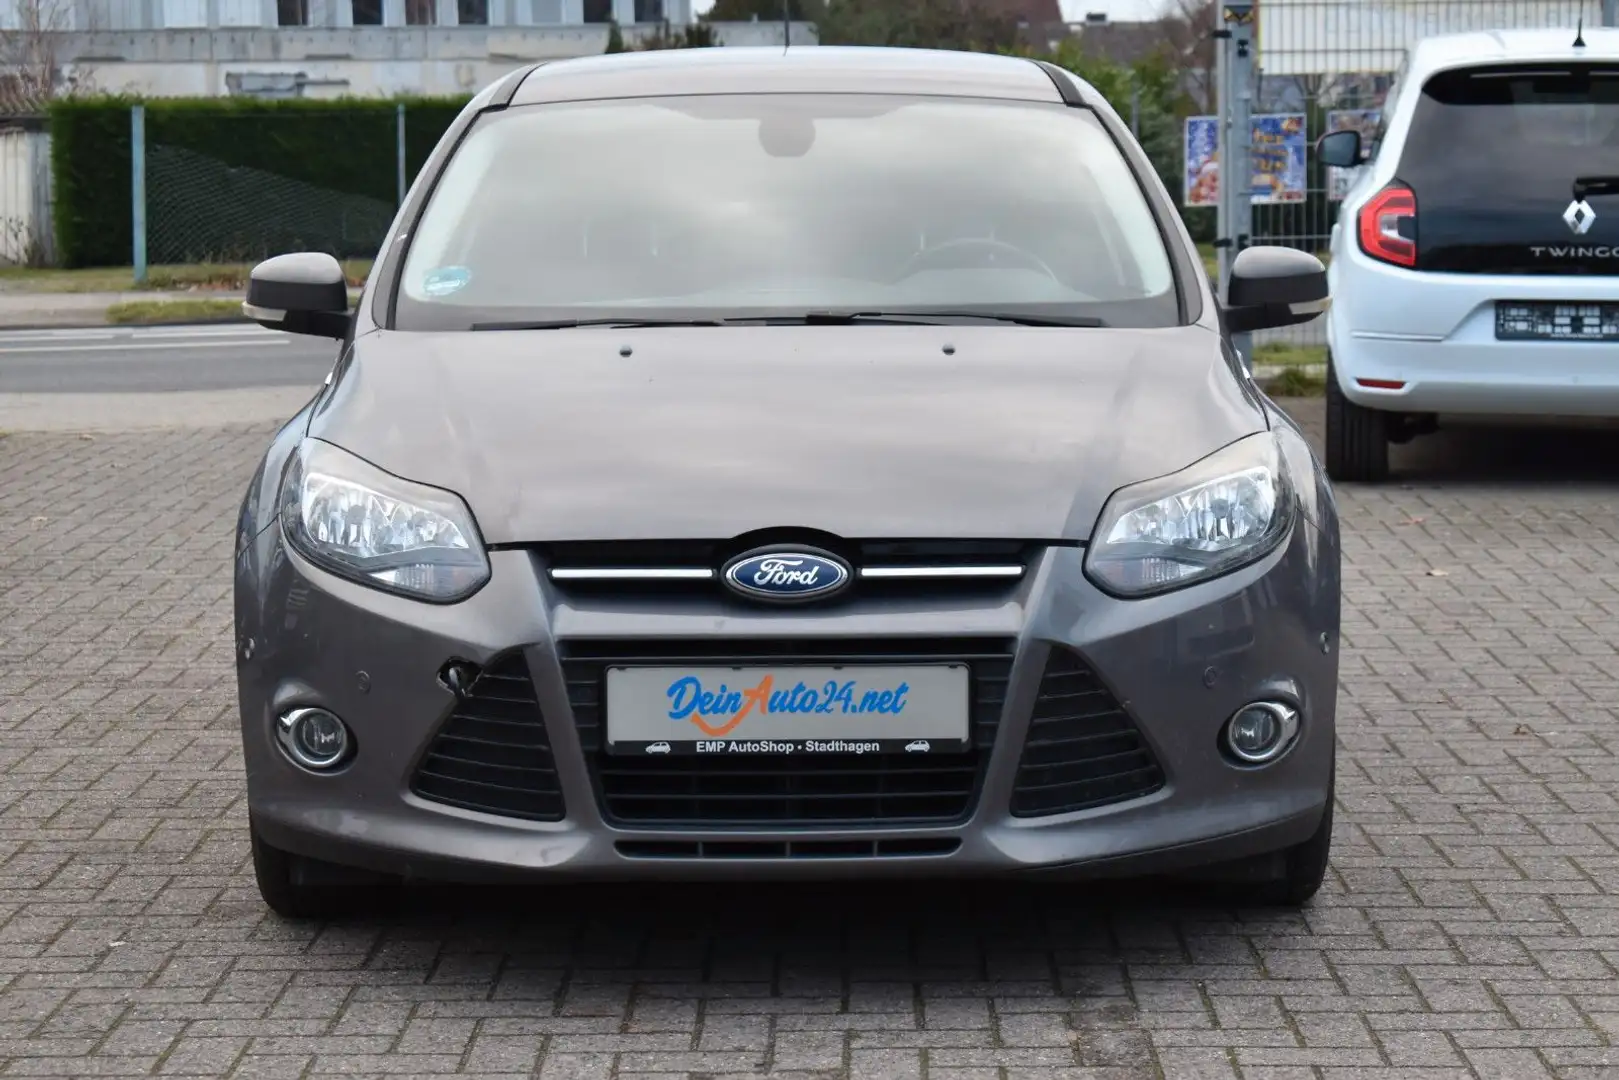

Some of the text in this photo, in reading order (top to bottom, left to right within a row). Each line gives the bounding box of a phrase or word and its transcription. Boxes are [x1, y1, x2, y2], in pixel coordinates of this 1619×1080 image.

[754, 558, 819, 585] Ford
[667, 674, 909, 736] DeinAuto24.net
[696, 740, 880, 754] EMP AutoShop Stadthagen
